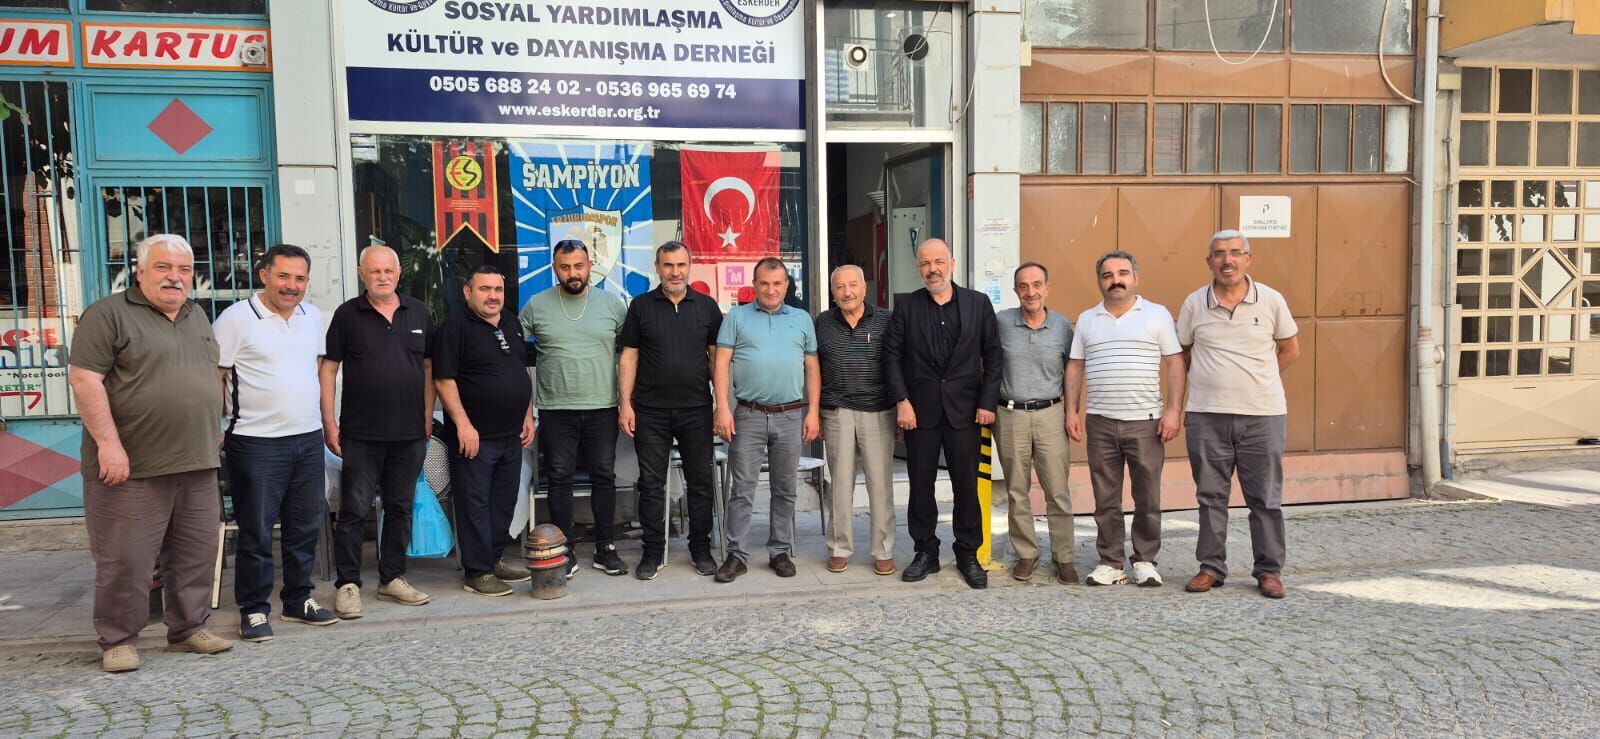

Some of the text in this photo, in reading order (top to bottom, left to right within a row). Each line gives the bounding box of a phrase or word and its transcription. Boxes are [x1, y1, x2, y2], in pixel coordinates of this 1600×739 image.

[444, 1, 723, 33] SOSYAL YARDIMLAŞMA
[387, 29, 775, 65] KÜLTÜR ve DAYANIŞMA DERNEĞİ
[430, 75, 480, 92] 0505
[485, 77, 522, 94] 688
[527, 78, 552, 95] 24
[556, 80, 580, 95] 02
[596, 81, 643, 97] 0536
[648, 82, 683, 98] 965
[687, 83, 710, 99] 69
[715, 84, 737, 99] 74
[498, 103, 660, 121] www.eskerder.org.tr
[522, 160, 640, 191] ŞAMPİYON
